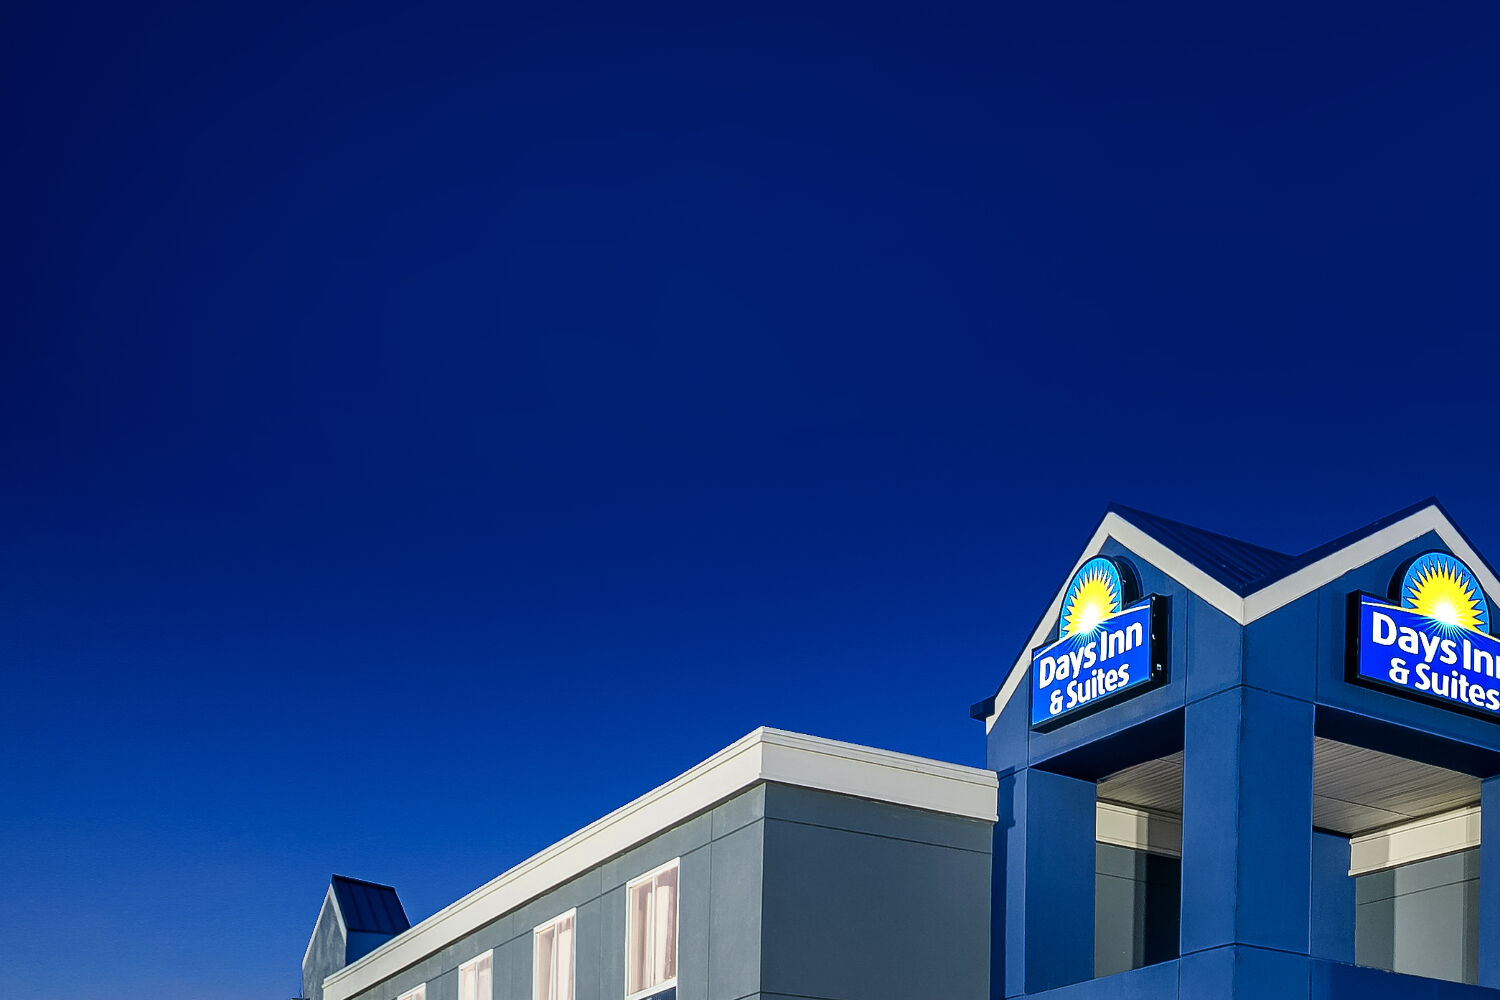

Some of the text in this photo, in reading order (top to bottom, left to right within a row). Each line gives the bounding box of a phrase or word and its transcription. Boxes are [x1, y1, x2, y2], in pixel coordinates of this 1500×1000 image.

[1039, 622, 1143, 689] Days Inn
[1372, 611, 1458, 665] Days
[1049, 663, 1130, 715] & Suites
[1388, 657, 1500, 711] & Suites
